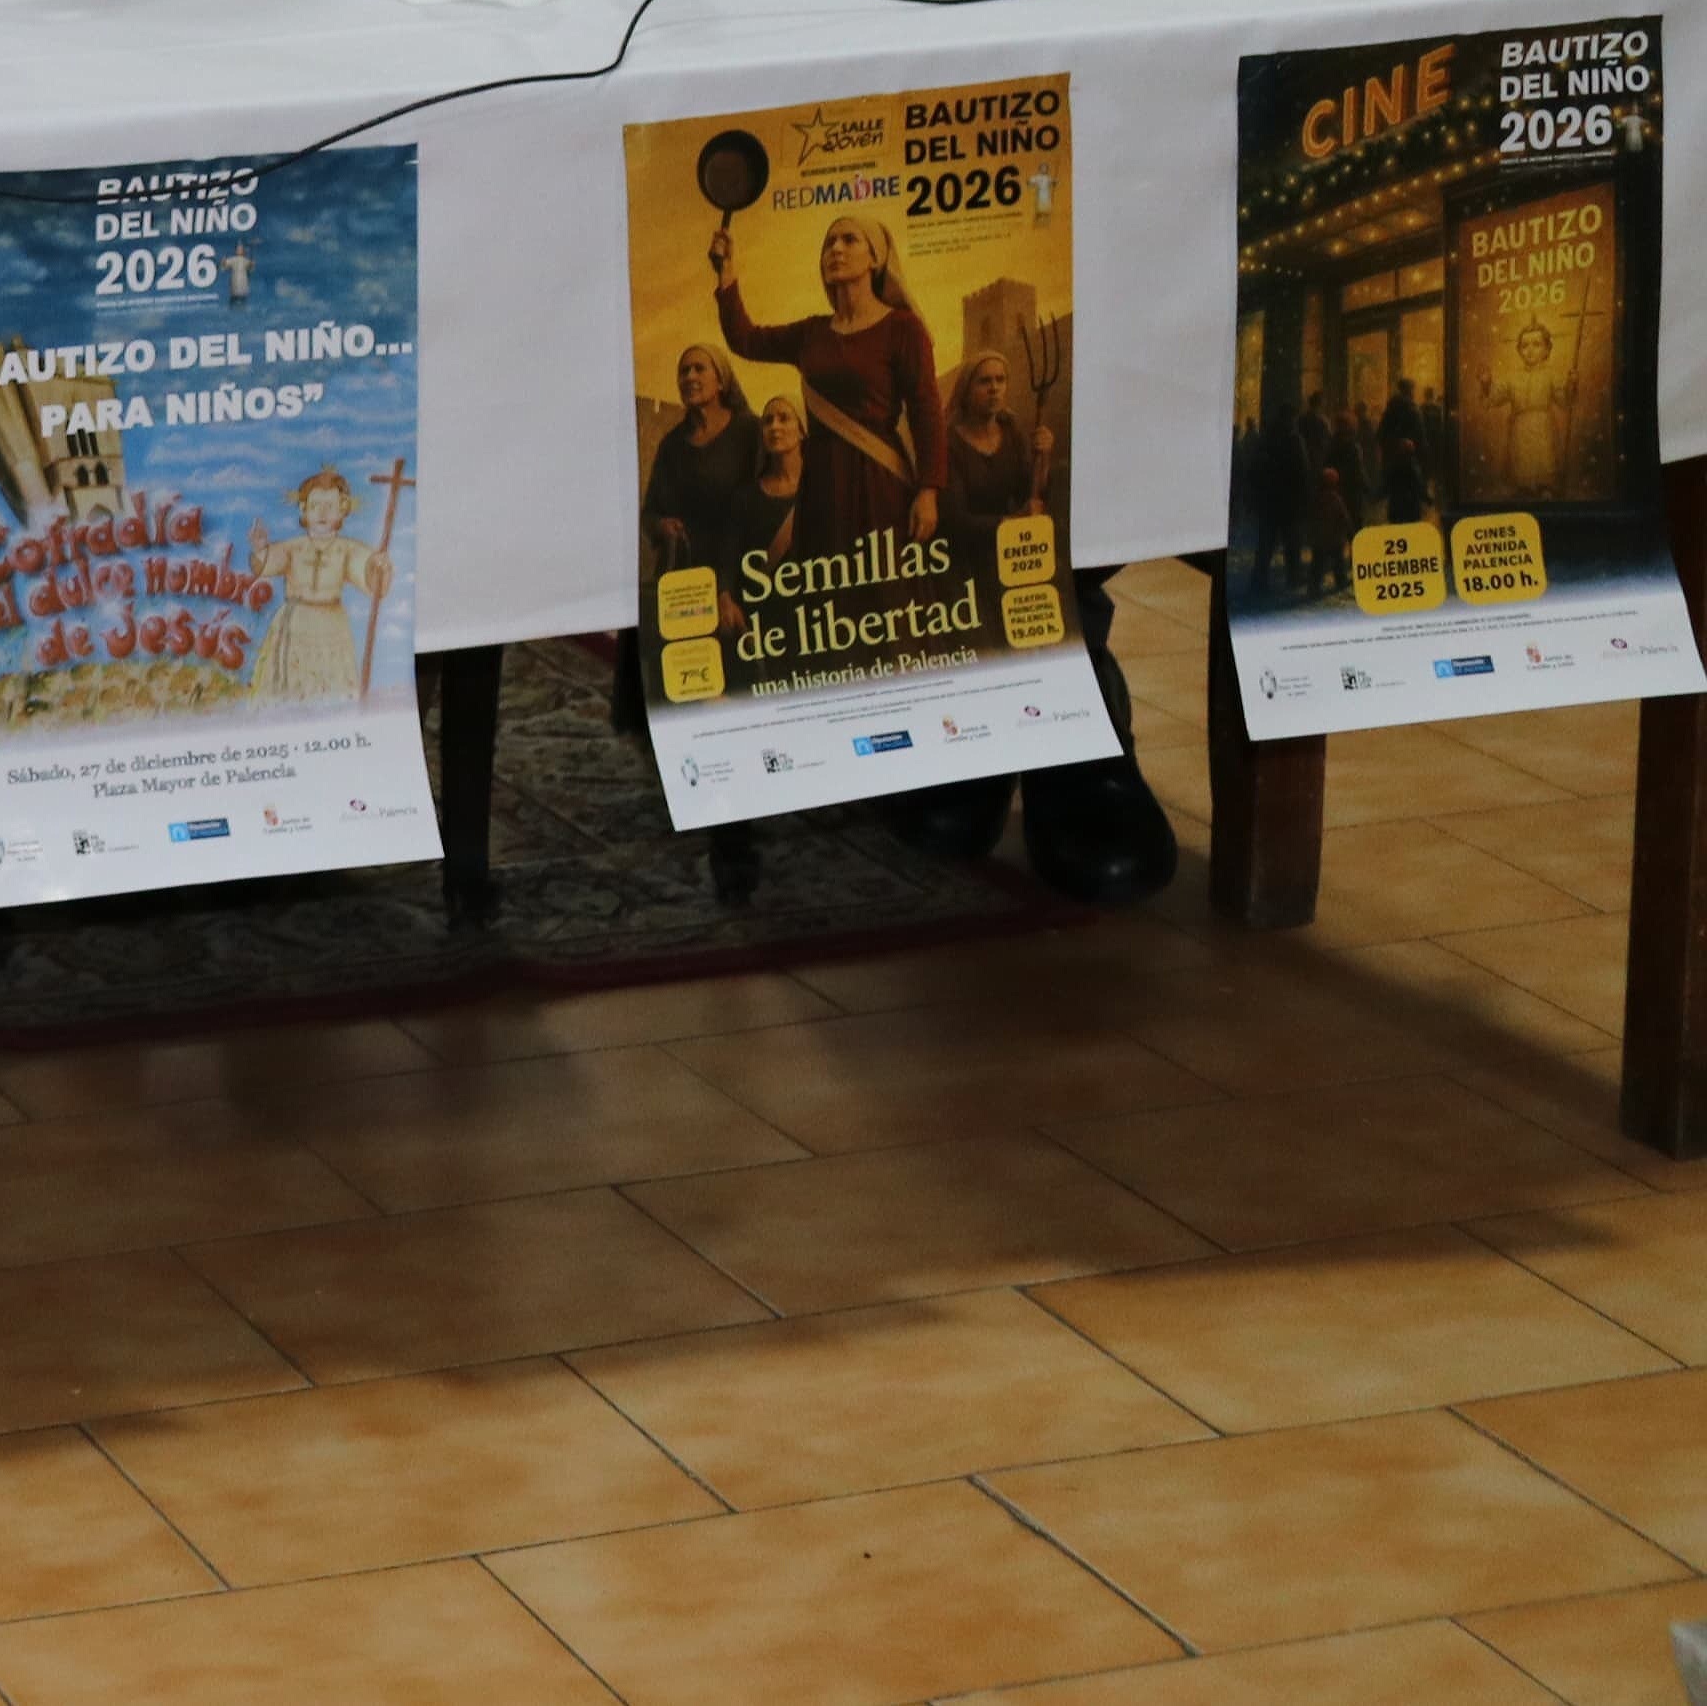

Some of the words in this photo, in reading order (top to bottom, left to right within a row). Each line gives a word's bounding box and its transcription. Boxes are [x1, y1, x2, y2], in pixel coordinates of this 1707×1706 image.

[1501, 30, 1649, 68] BAUTIZO
[1500, 74, 1559, 103] DEL
[1568, 58, 1650, 97] NIÑO
[905, 90, 1060, 129] BAUTIZO
[1301, 42, 1456, 160] CINE
[841, 118, 884, 132] SALLE
[905, 135, 966, 165] DEL
[976, 120, 1060, 157] NIÑO
[1500, 104, 1613, 153] 2026
[97, 168, 259, 205] BAUTIZO
[772, 171, 900, 210] REDMADRE
[906, 165, 1021, 217] 2026
[95, 211, 160, 242] DEL
[170, 199, 257, 236] NIÑO
[1472, 203, 1603, 259] BAUTIZO
[95, 244, 217, 294] 2026
[1477, 257, 1524, 288] DEL
[1528, 240, 1595, 277] NIÑO
[1498, 279, 1566, 314] 2026
[169, 333, 251, 369] DEL
[41, 396, 153, 437] PARA
[1003, 543, 1048, 559] ENERO
[1384, 538, 1408, 555] 29
[1465, 539, 1528, 556] AVENIDA
[1473, 525, 1516, 540] CINES
[741, 527, 950, 603] Semillas
[1357, 557, 1439, 581] DICIEMBRE
[1462, 572, 1515, 592] 18.00
[1520, 570, 1539, 587] h.
[1463, 553, 1533, 570] PALENCIA
[1375, 581, 1425, 600] 2025
[737, 612, 786, 662] de
[795, 579, 983, 656] libertad
[1010, 611, 1055, 624] PALENCIA
[38, 618, 93, 666] de
[751, 680, 789, 697] una
[792, 664, 865, 692] historia
[870, 657, 894, 680] de
[898, 646, 979, 674] Palencia
[6, 765, 75, 785] Sábado,
[81, 764, 100, 779] 27
[105, 759, 126, 776] de
[131, 749, 217, 772] diciembre
[221, 746, 241, 763] de
[246, 744, 289, 761] 2025
[304, 738, 351, 753] 12.00
[355, 732, 372, 748] h.
[93, 782, 139, 798] Plaza
[142, 775, 196, 796] Mayor
[201, 769, 222, 786] de
[226, 763, 297, 784] Palencia
